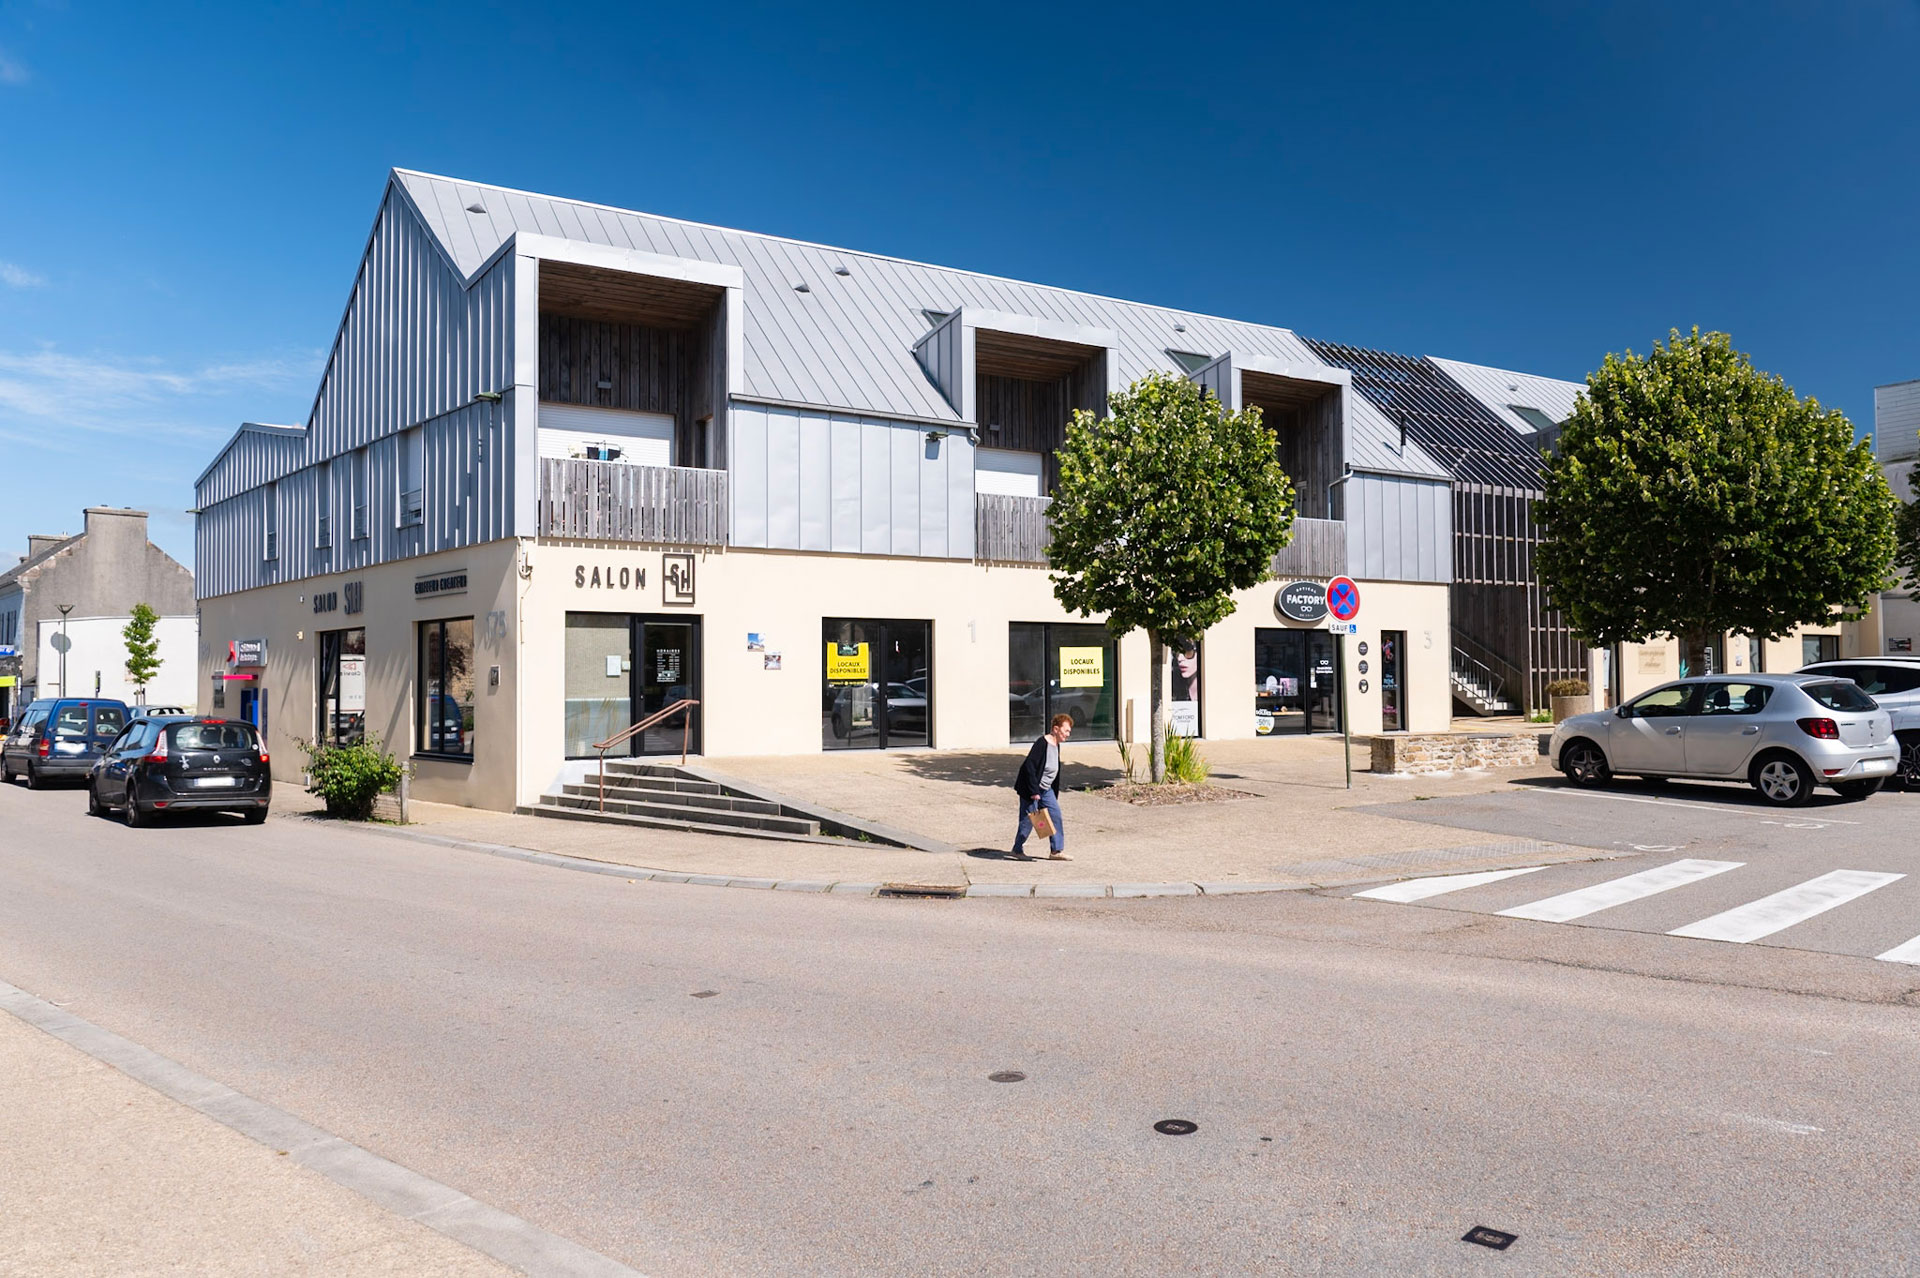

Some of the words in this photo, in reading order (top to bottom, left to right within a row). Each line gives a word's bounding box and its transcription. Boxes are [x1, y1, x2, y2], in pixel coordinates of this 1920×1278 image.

[575, 565, 646, 590] SALON
[313, 591, 338, 614] SALON
[1287, 594, 1326, 605] FACTORY
[1423, 630, 1433, 649] 3
